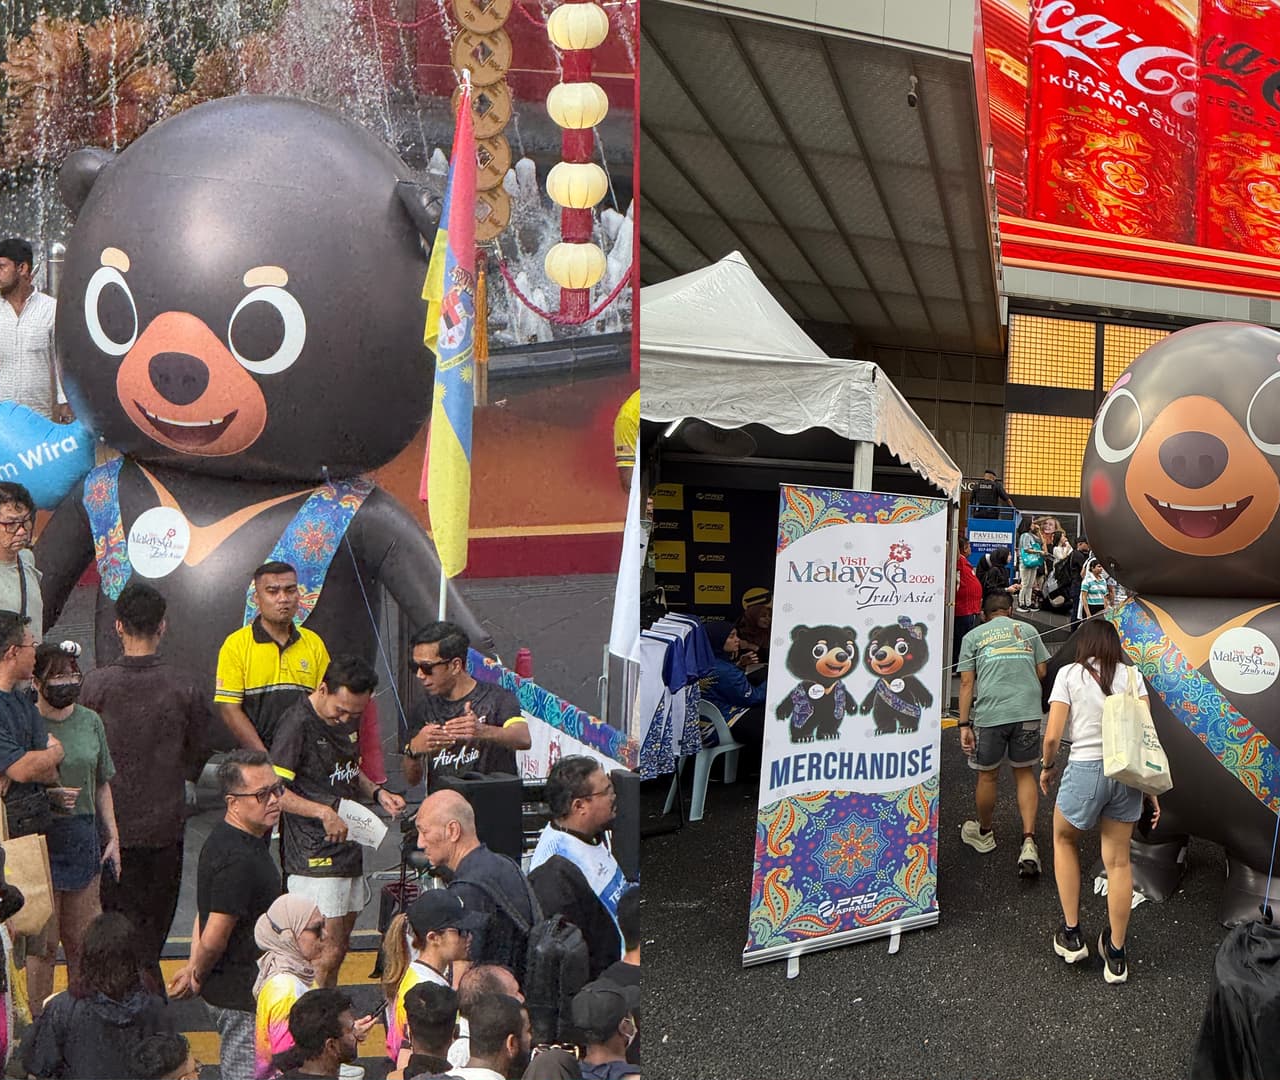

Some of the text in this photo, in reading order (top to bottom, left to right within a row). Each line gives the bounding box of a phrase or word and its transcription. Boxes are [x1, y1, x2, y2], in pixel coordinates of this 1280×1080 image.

[1049, 74, 1139, 117] KURANG
[1068, 69, 1127, 101] RASA
[18, 435, 79, 471] Wira
[973, 532, 1009, 540] PAVILION
[840, 555, 867, 566] Visit
[786, 560, 935, 588] Malaysia 2026
[856, 585, 933, 610] Truly Asia
[1213, 650, 1263, 666] Malaysia
[433, 746, 480, 770] AirAsia
[769, 744, 933, 791] MERCHANDISE
[329, 761, 361, 788] AirAsia
[835, 892, 879, 909] PRO
[835, 902, 879, 915] APPAREL
